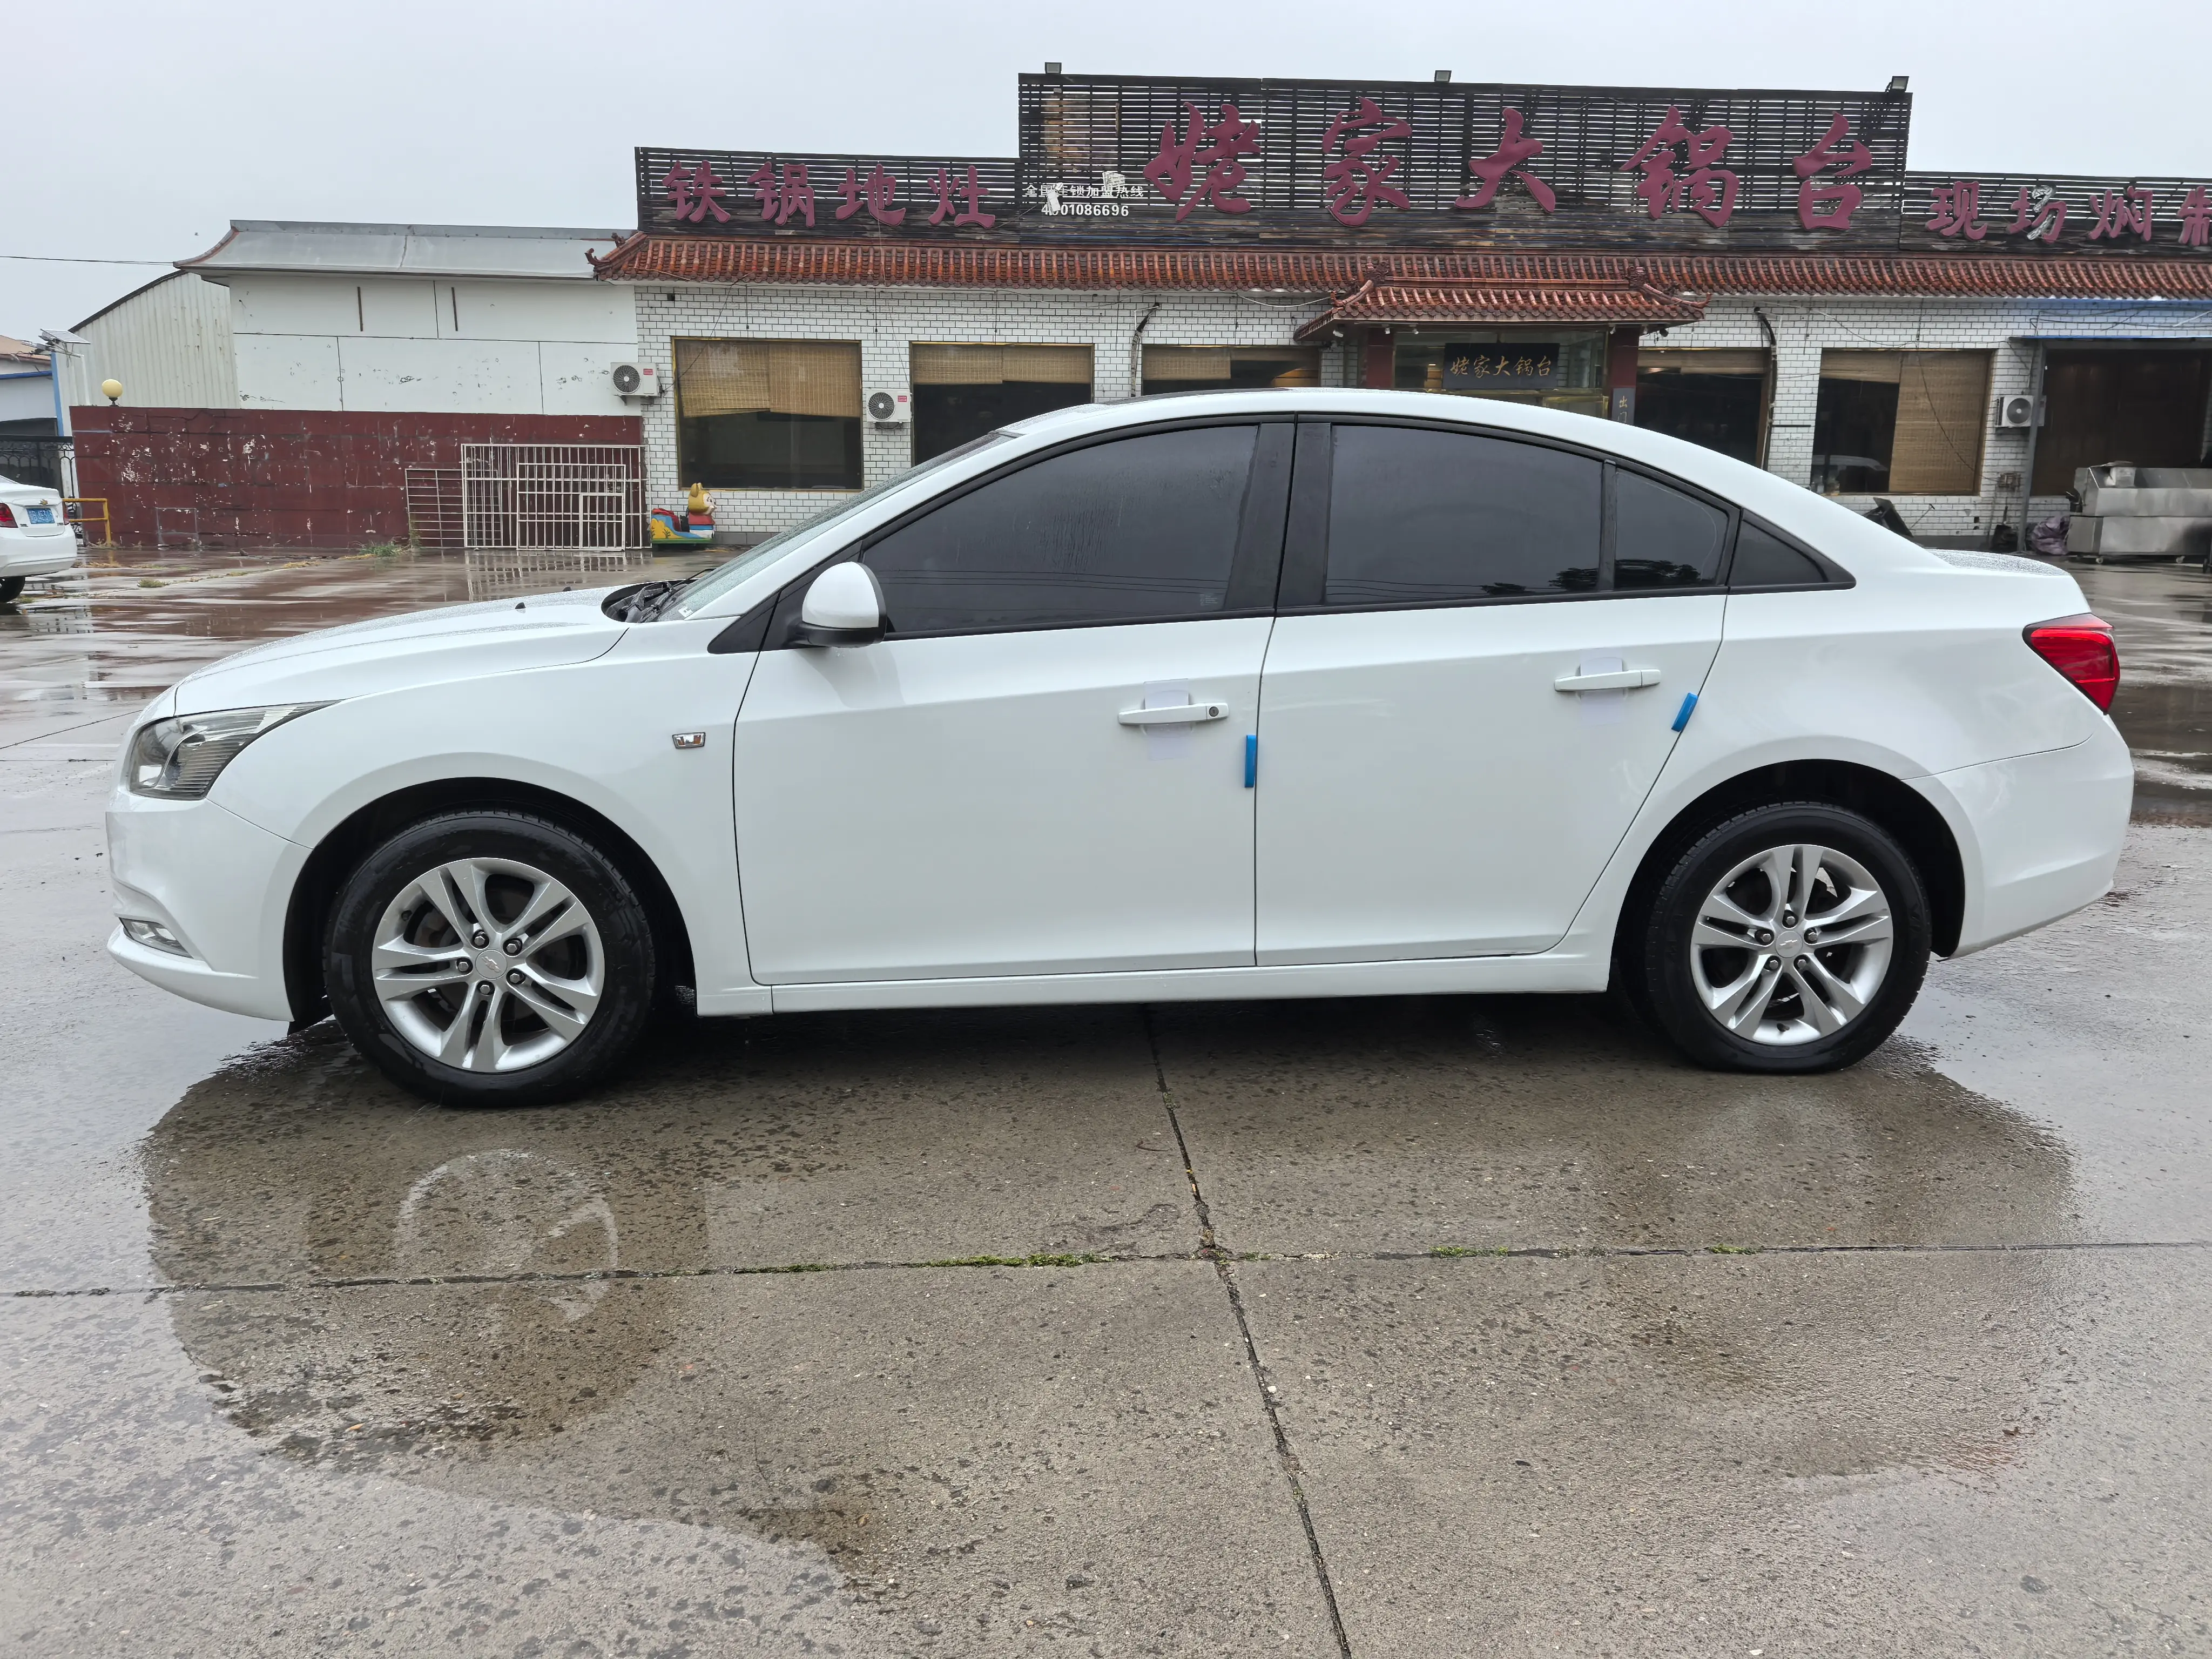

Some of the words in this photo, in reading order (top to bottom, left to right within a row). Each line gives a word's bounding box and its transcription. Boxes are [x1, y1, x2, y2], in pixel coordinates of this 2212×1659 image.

[1142, 96, 1872, 231] 姥家大锅台
[662, 160, 996, 228] 铁锅地灶
[1041, 204, 1129, 217] 401086696
[1450, 354, 1552, 379] 姥家大锅台
